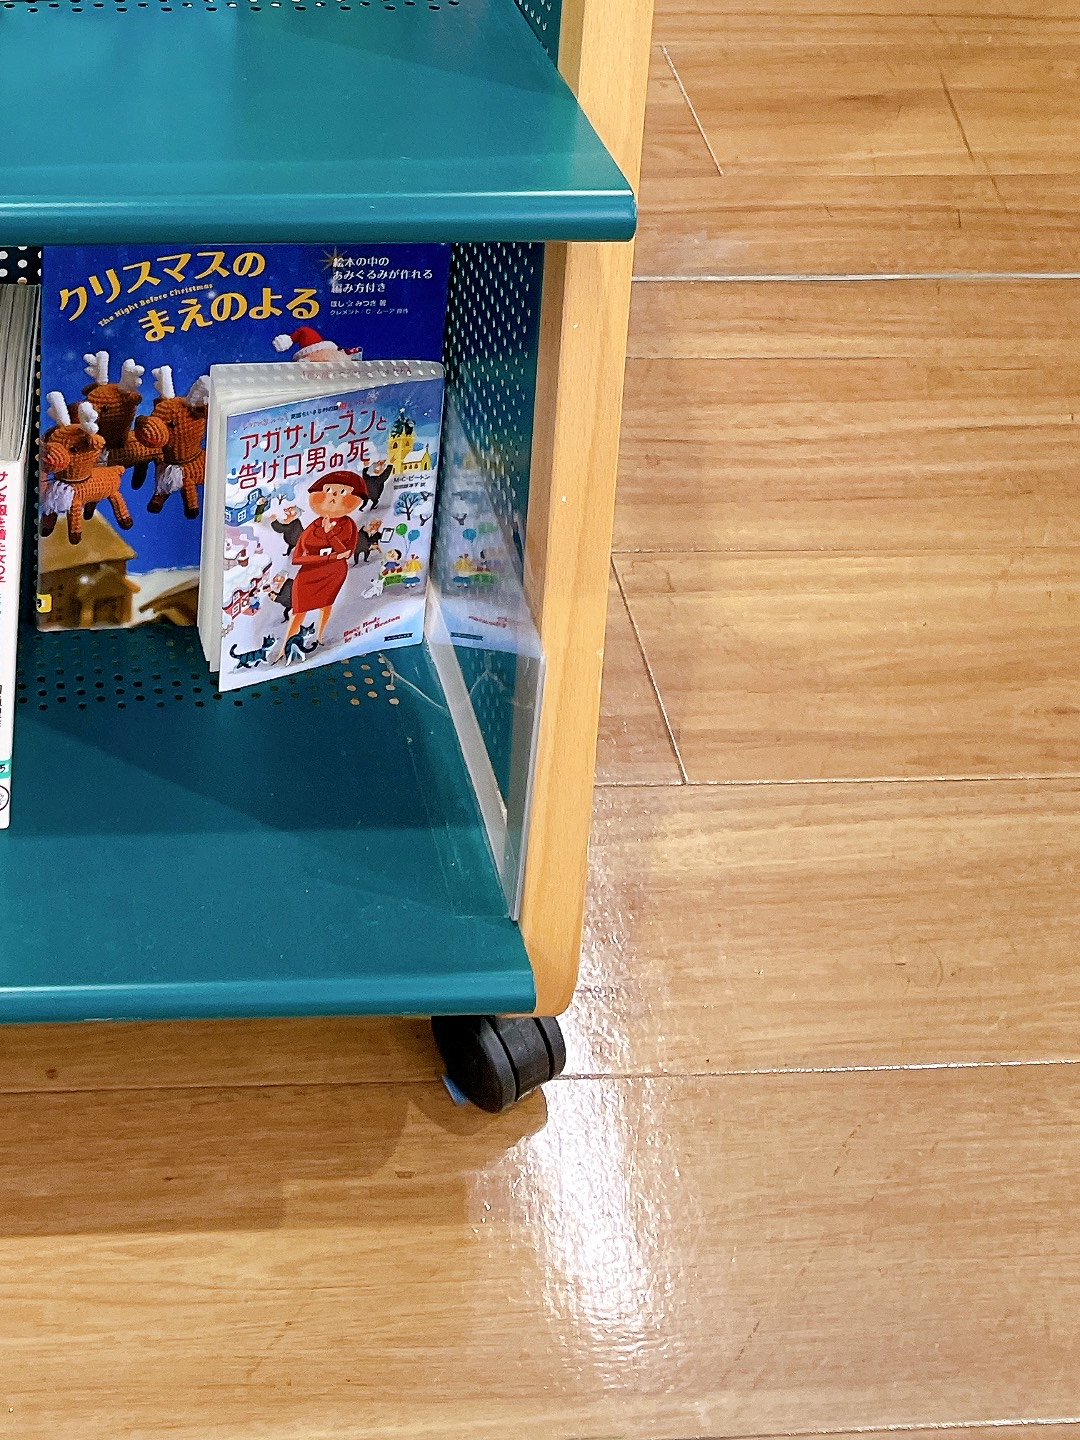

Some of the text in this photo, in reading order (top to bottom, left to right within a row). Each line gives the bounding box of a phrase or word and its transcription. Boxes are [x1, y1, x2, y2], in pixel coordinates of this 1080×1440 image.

[59, 250, 266, 322] クリスマスの
[332, 256, 390, 268] 絵本の中の
[332, 269, 433, 280] あみぐるみが作れる
[97, 283, 214, 327] The Night Before Christmas
[137, 287, 321, 343] まえのよる
[239, 409, 389, 460] アガサ・レーズンと
[237, 437, 371, 490] 告げ口男の死
